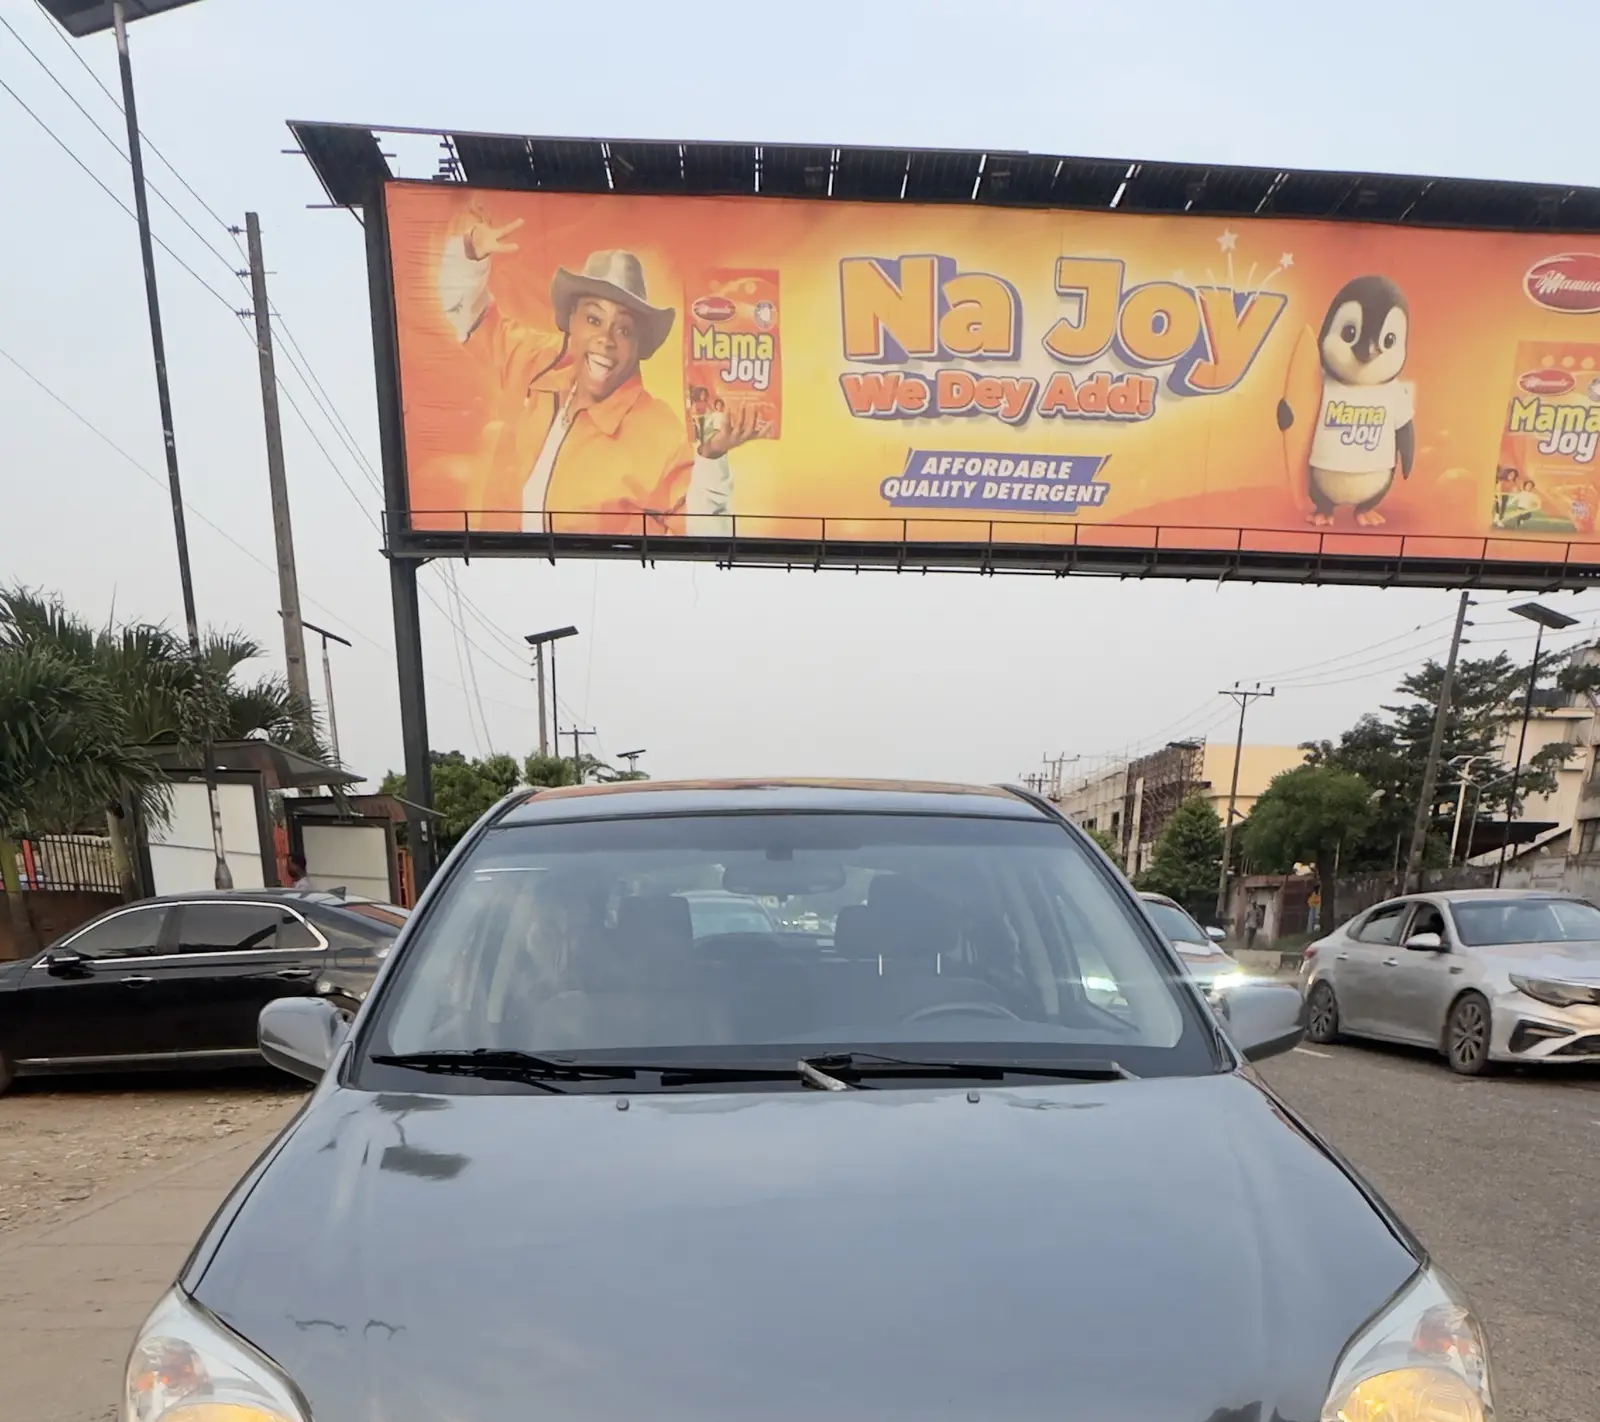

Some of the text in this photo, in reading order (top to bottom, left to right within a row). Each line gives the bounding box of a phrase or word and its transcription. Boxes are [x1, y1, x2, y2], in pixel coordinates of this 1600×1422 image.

[839, 254, 1288, 395] Na Joy
[690, 325, 774, 360] Mama
[720, 358, 770, 391] Joy
[839, 368, 1158, 426] We Dey Add!
[1324, 400, 1386, 427] Mama
[1509, 397, 1600, 432] Mama
[1340, 425, 1382, 451] Joy
[1537, 430, 1599, 464] Joy
[920, 456, 1073, 480] AFFORDABLE
[883, 479, 1106, 503] QUALITY DETERGENT
